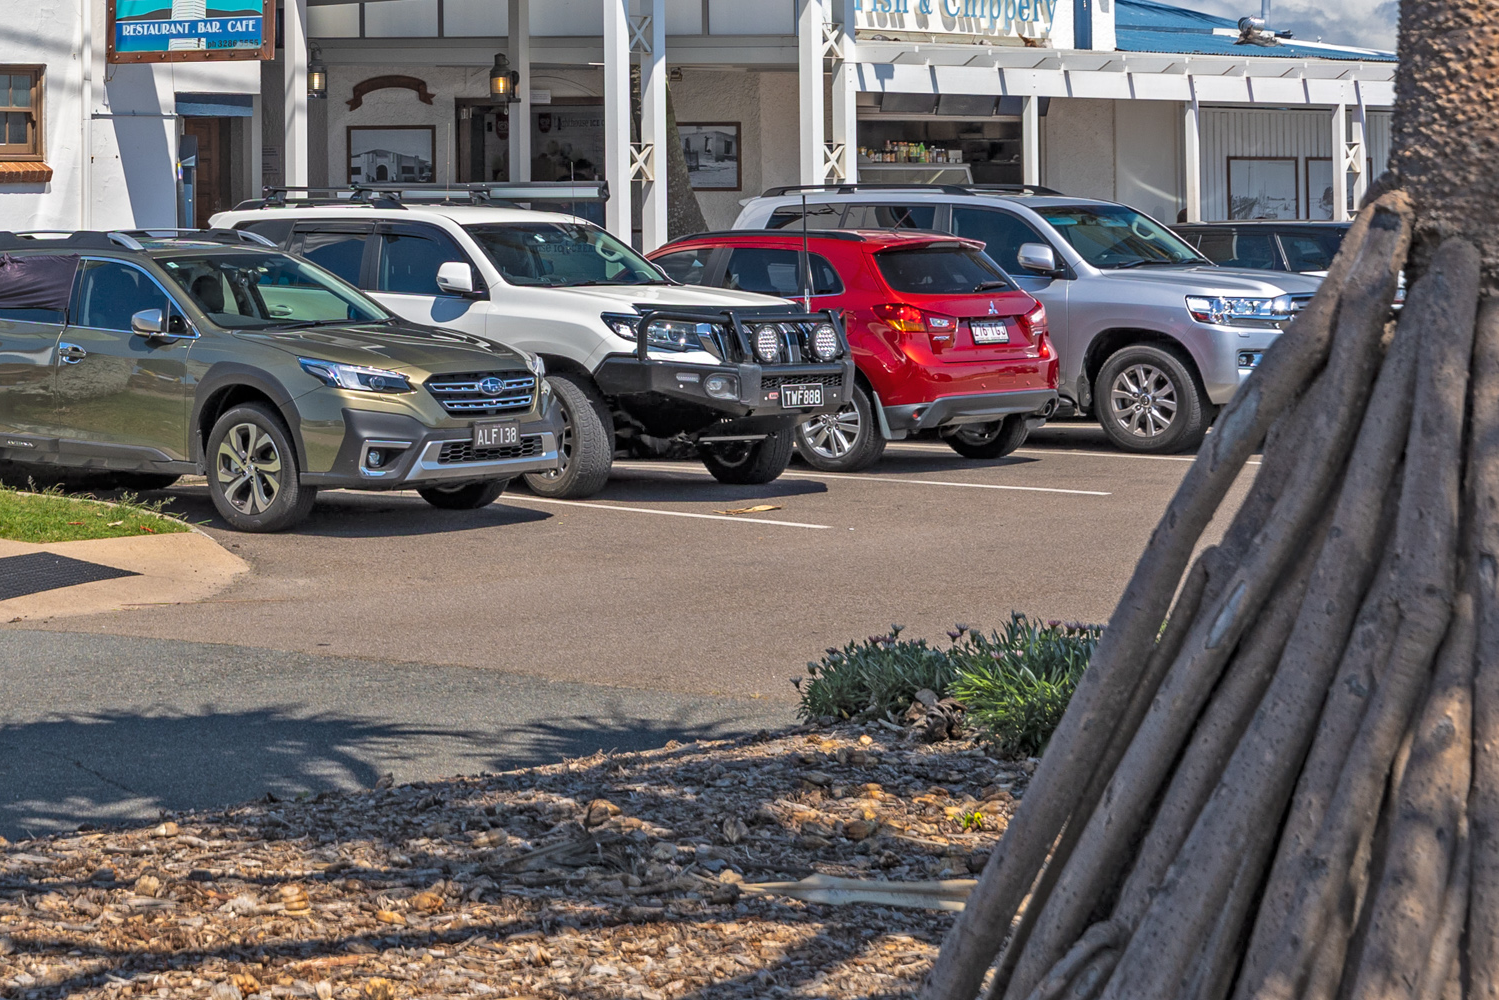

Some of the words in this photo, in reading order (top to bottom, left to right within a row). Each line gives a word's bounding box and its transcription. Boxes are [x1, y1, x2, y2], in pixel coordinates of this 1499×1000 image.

[122, 22, 191, 37] RESTAURANT
[227, 20, 256, 32] CAFE
[785, 389, 821, 406] TWF888
[477, 427, 517, 446] ALF138
